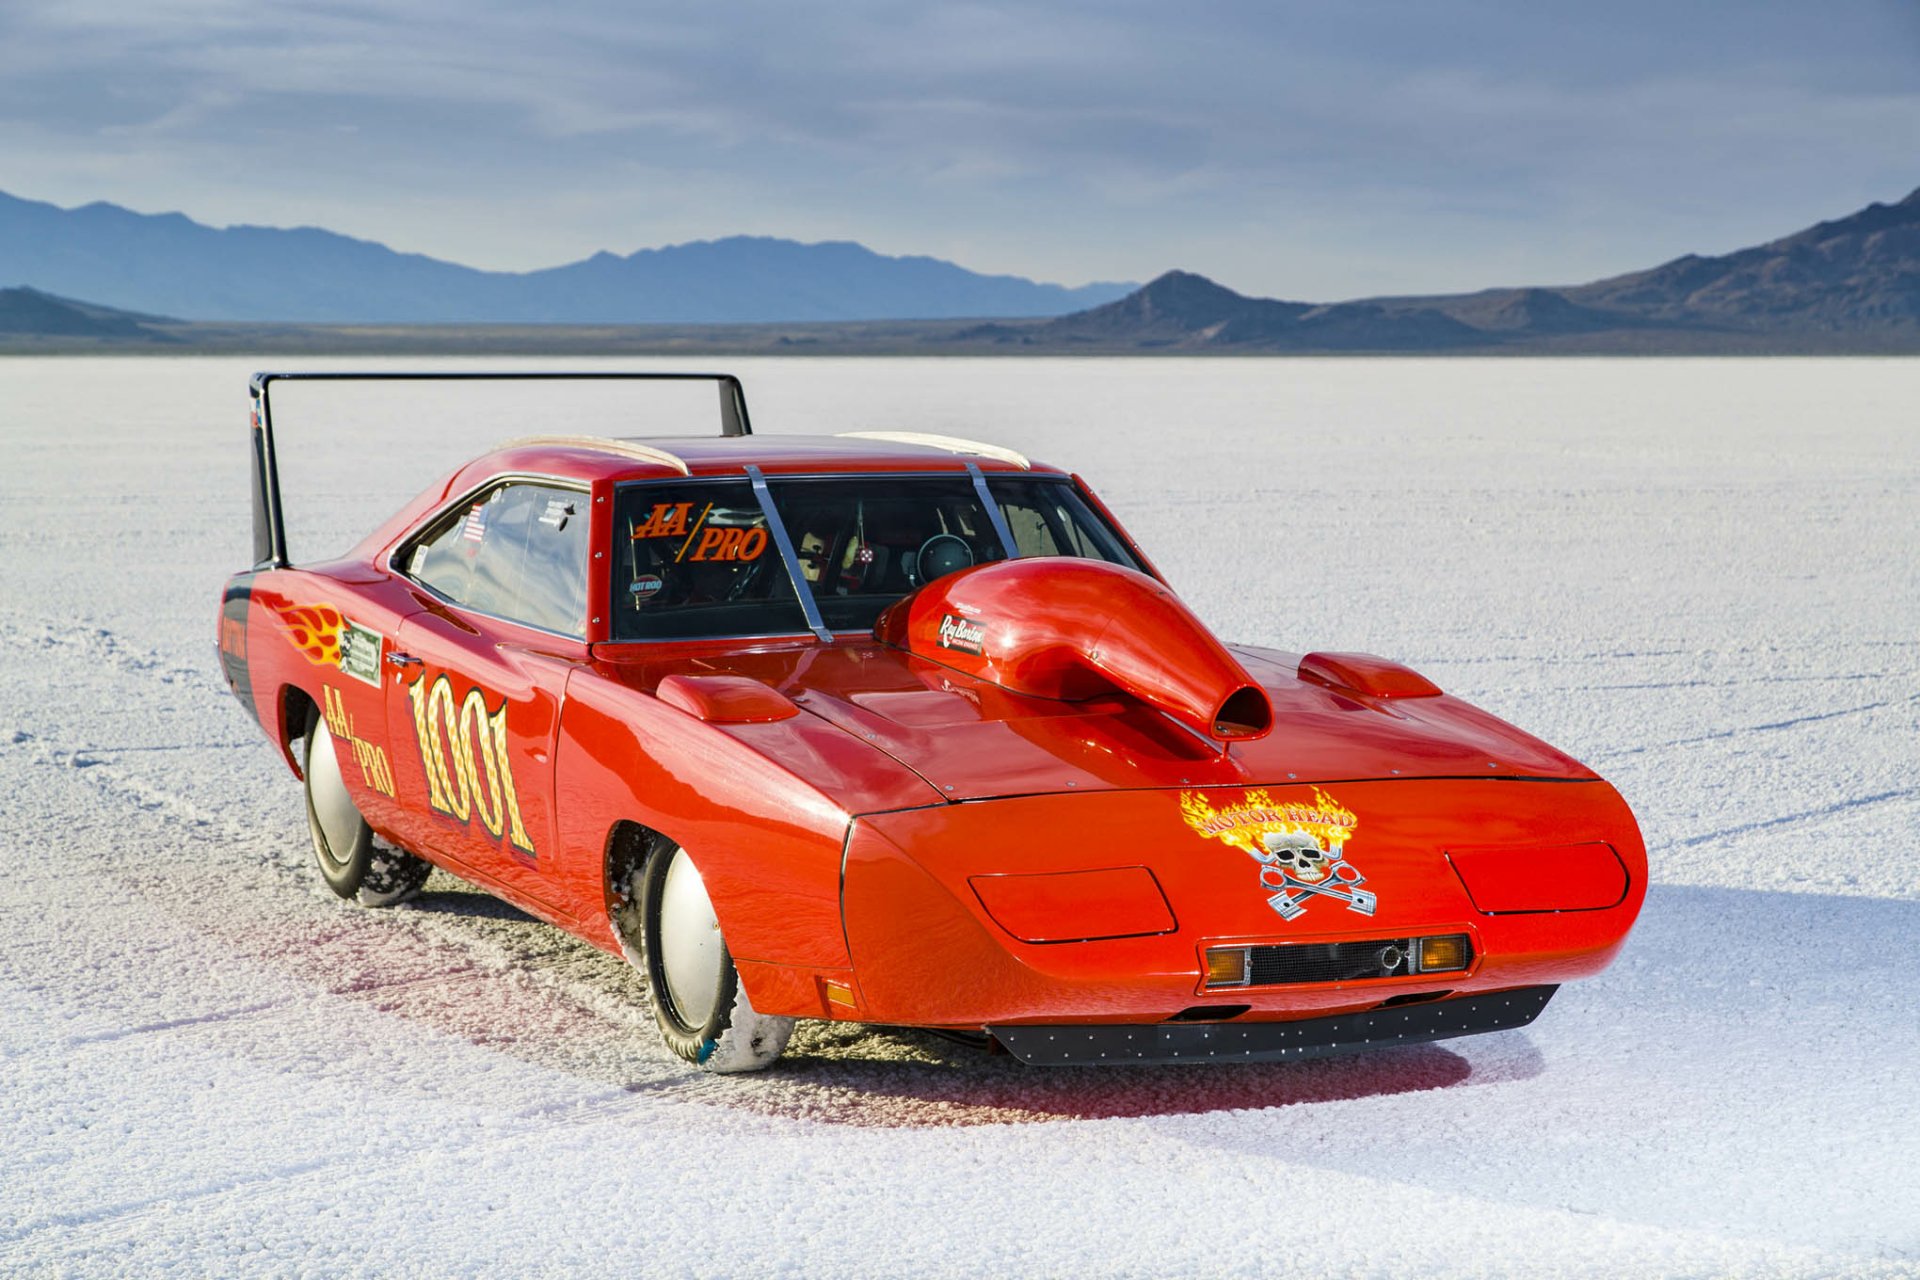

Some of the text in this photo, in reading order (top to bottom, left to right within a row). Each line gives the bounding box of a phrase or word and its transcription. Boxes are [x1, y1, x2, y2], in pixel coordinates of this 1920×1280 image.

[409, 670, 536, 858] 1001
[1203, 807, 1354, 834] MOTOR HEAD
